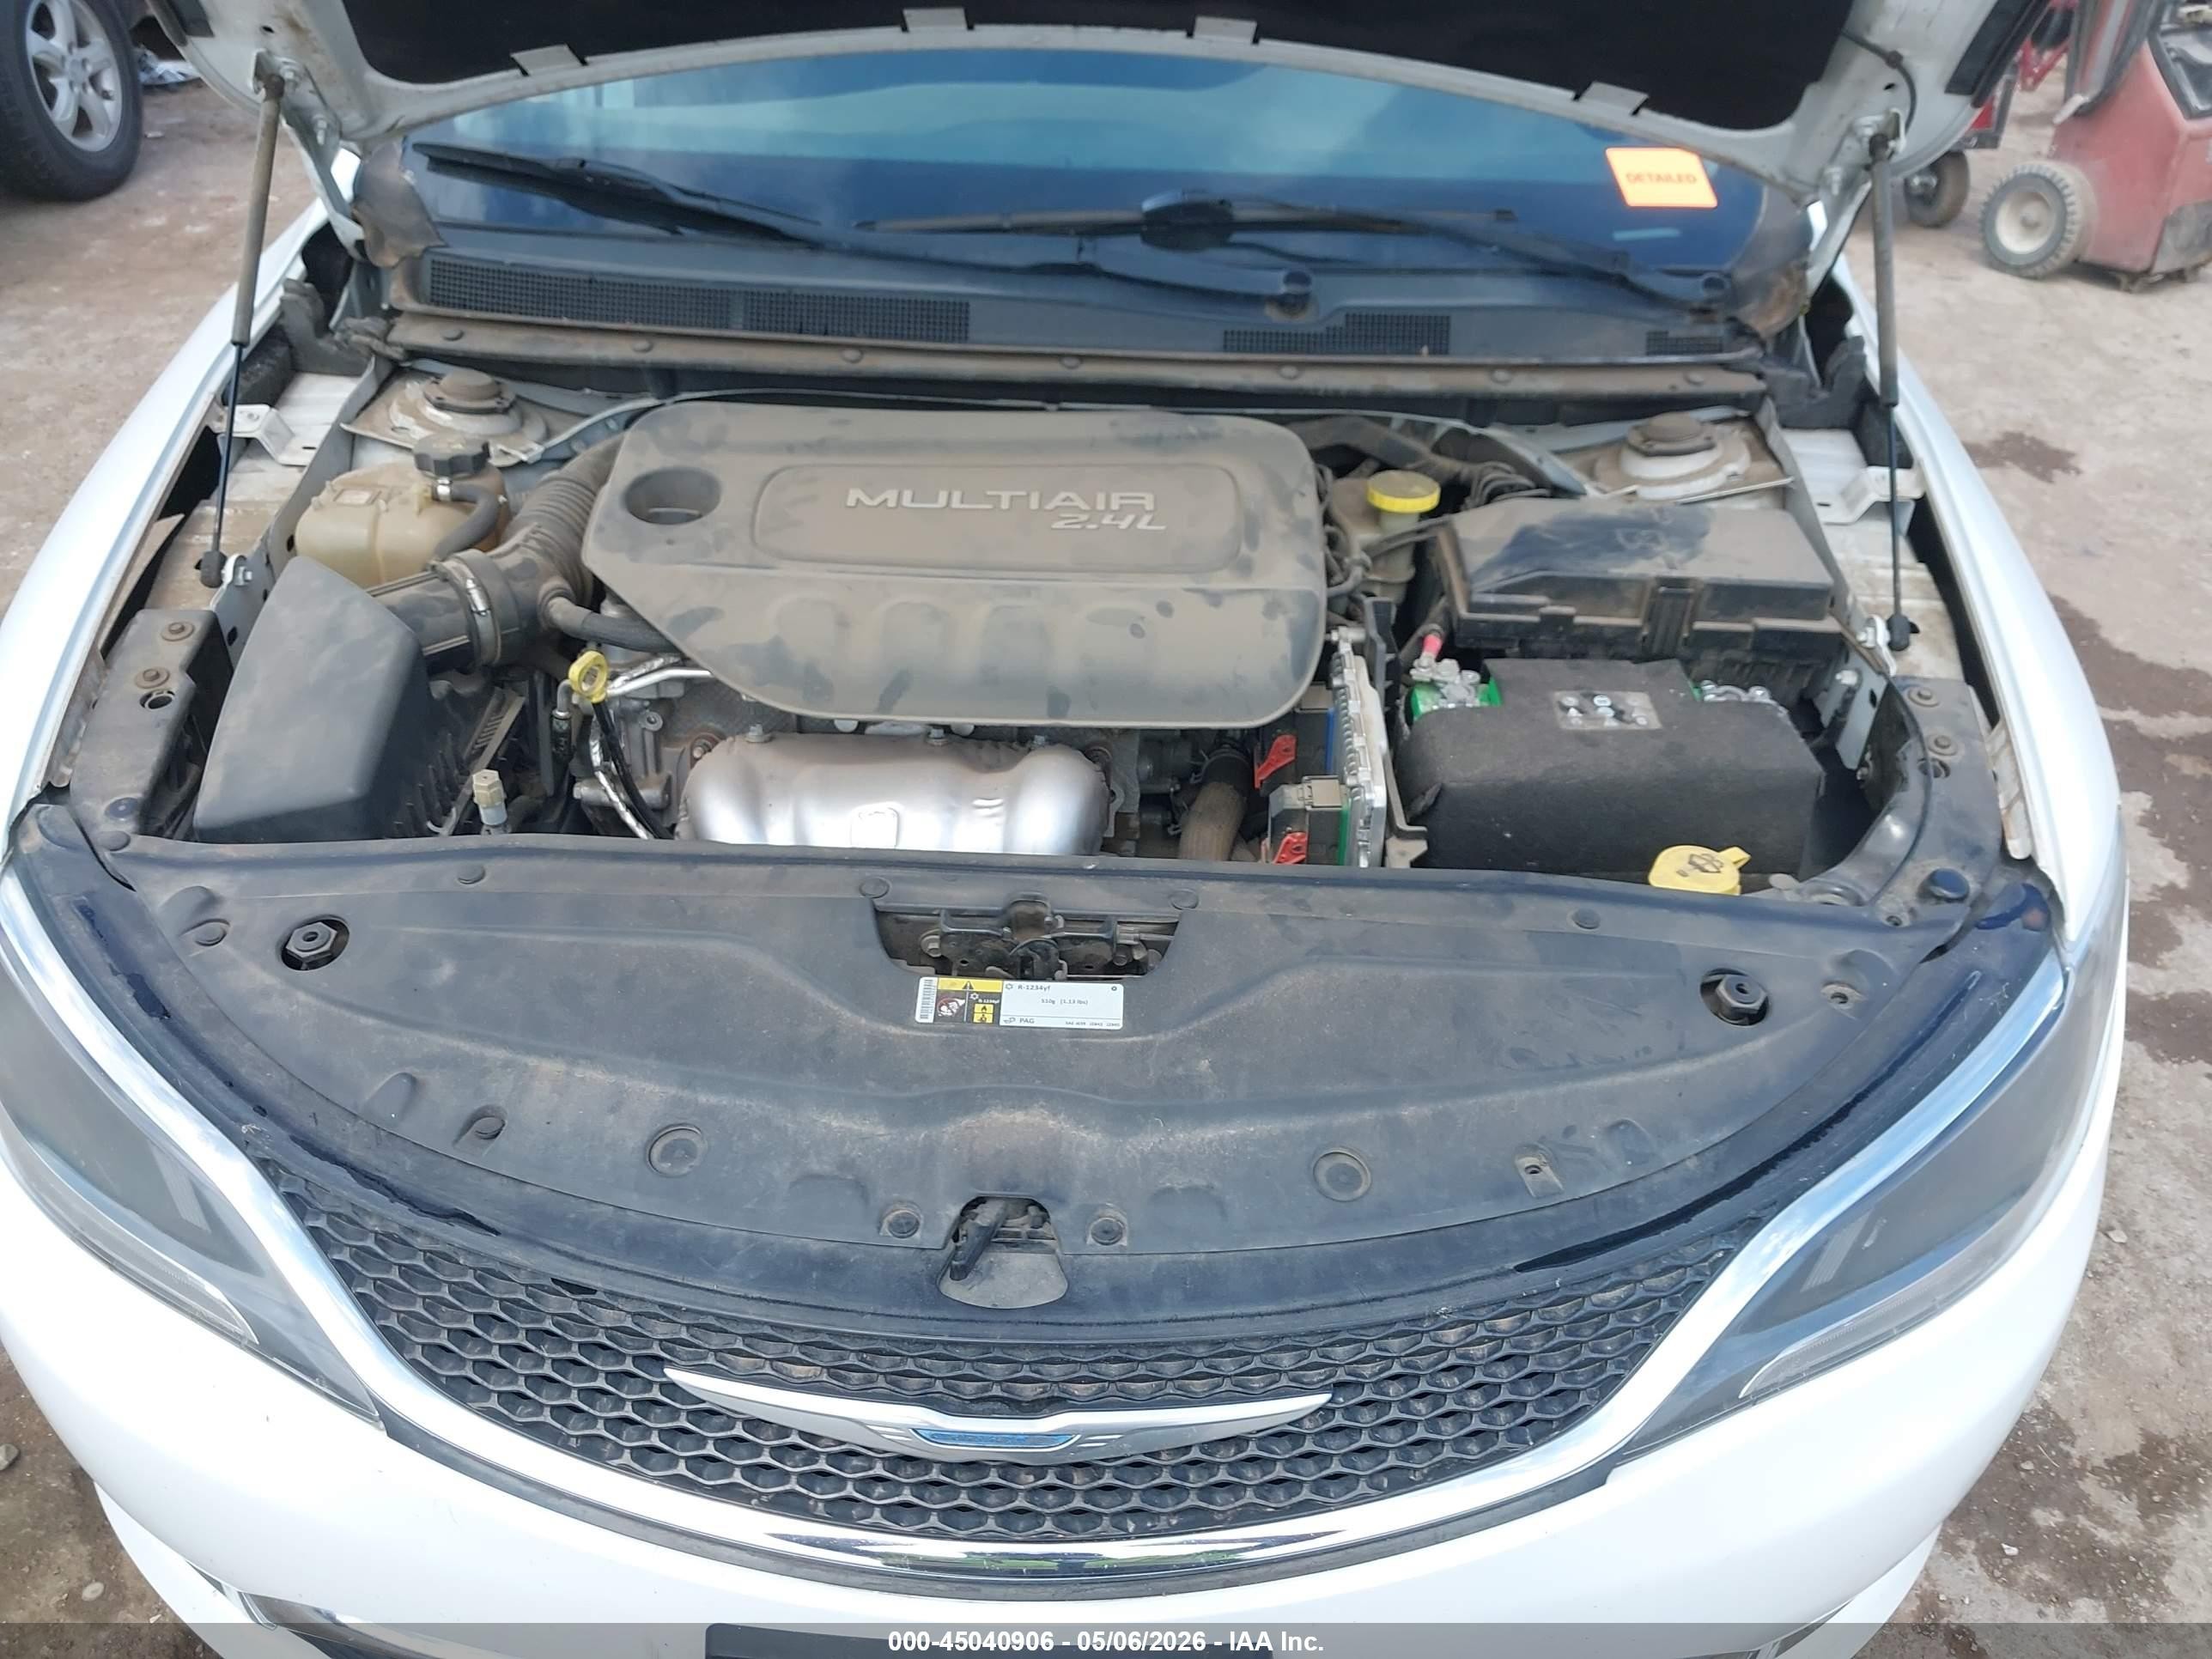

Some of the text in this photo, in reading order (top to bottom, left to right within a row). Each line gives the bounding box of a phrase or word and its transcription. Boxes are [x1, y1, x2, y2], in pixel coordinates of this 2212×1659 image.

[1626, 172, 1697, 184] DETAILED
[845, 487, 1156, 512] MULTIAIR
[1050, 512, 1167, 531] 2.4L
